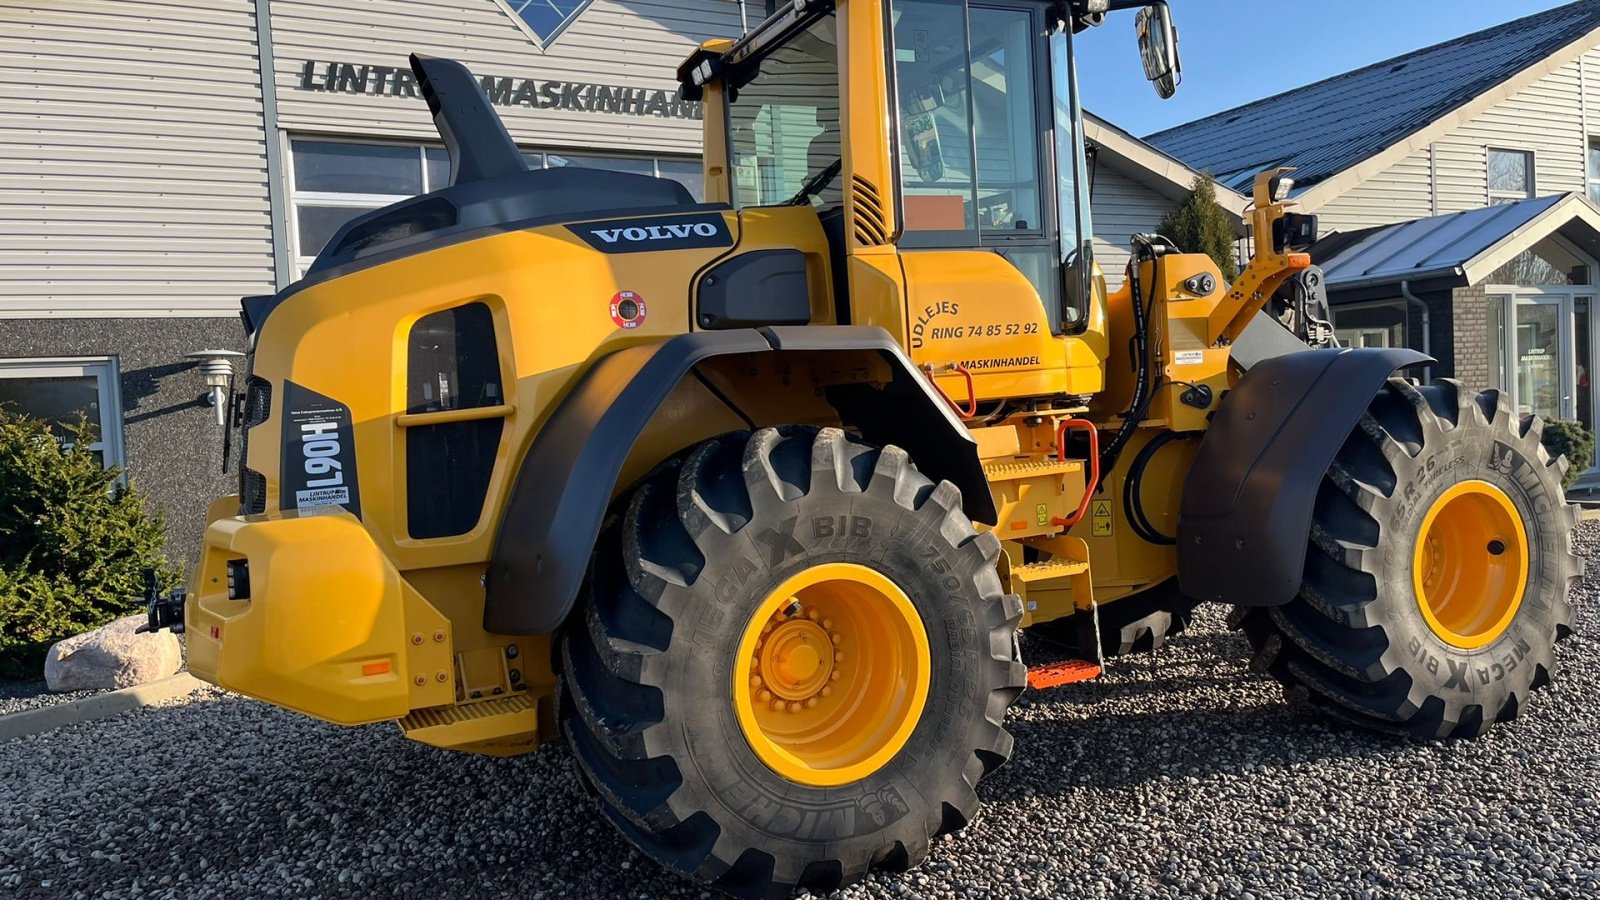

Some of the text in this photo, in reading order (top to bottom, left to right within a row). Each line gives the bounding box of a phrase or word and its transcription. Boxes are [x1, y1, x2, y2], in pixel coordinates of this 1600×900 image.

[302, 60, 703, 120] LINTR MASKINHAN
[591, 223, 717, 243] VOLVO
[912, 301, 959, 349] UDLEJES
[931, 322, 1038, 340] RING 74 85 52 92
[960, 356, 1040, 369] MASKINHANDEL
[301, 422, 343, 488] L90H
[1416, 455, 1435, 483] 26
[299, 493, 347, 502] MASKINHANDEL
[753, 514, 808, 571] X
[813, 515, 872, 540] BIB
[1409, 636, 1531, 692] MEGA X BIB
